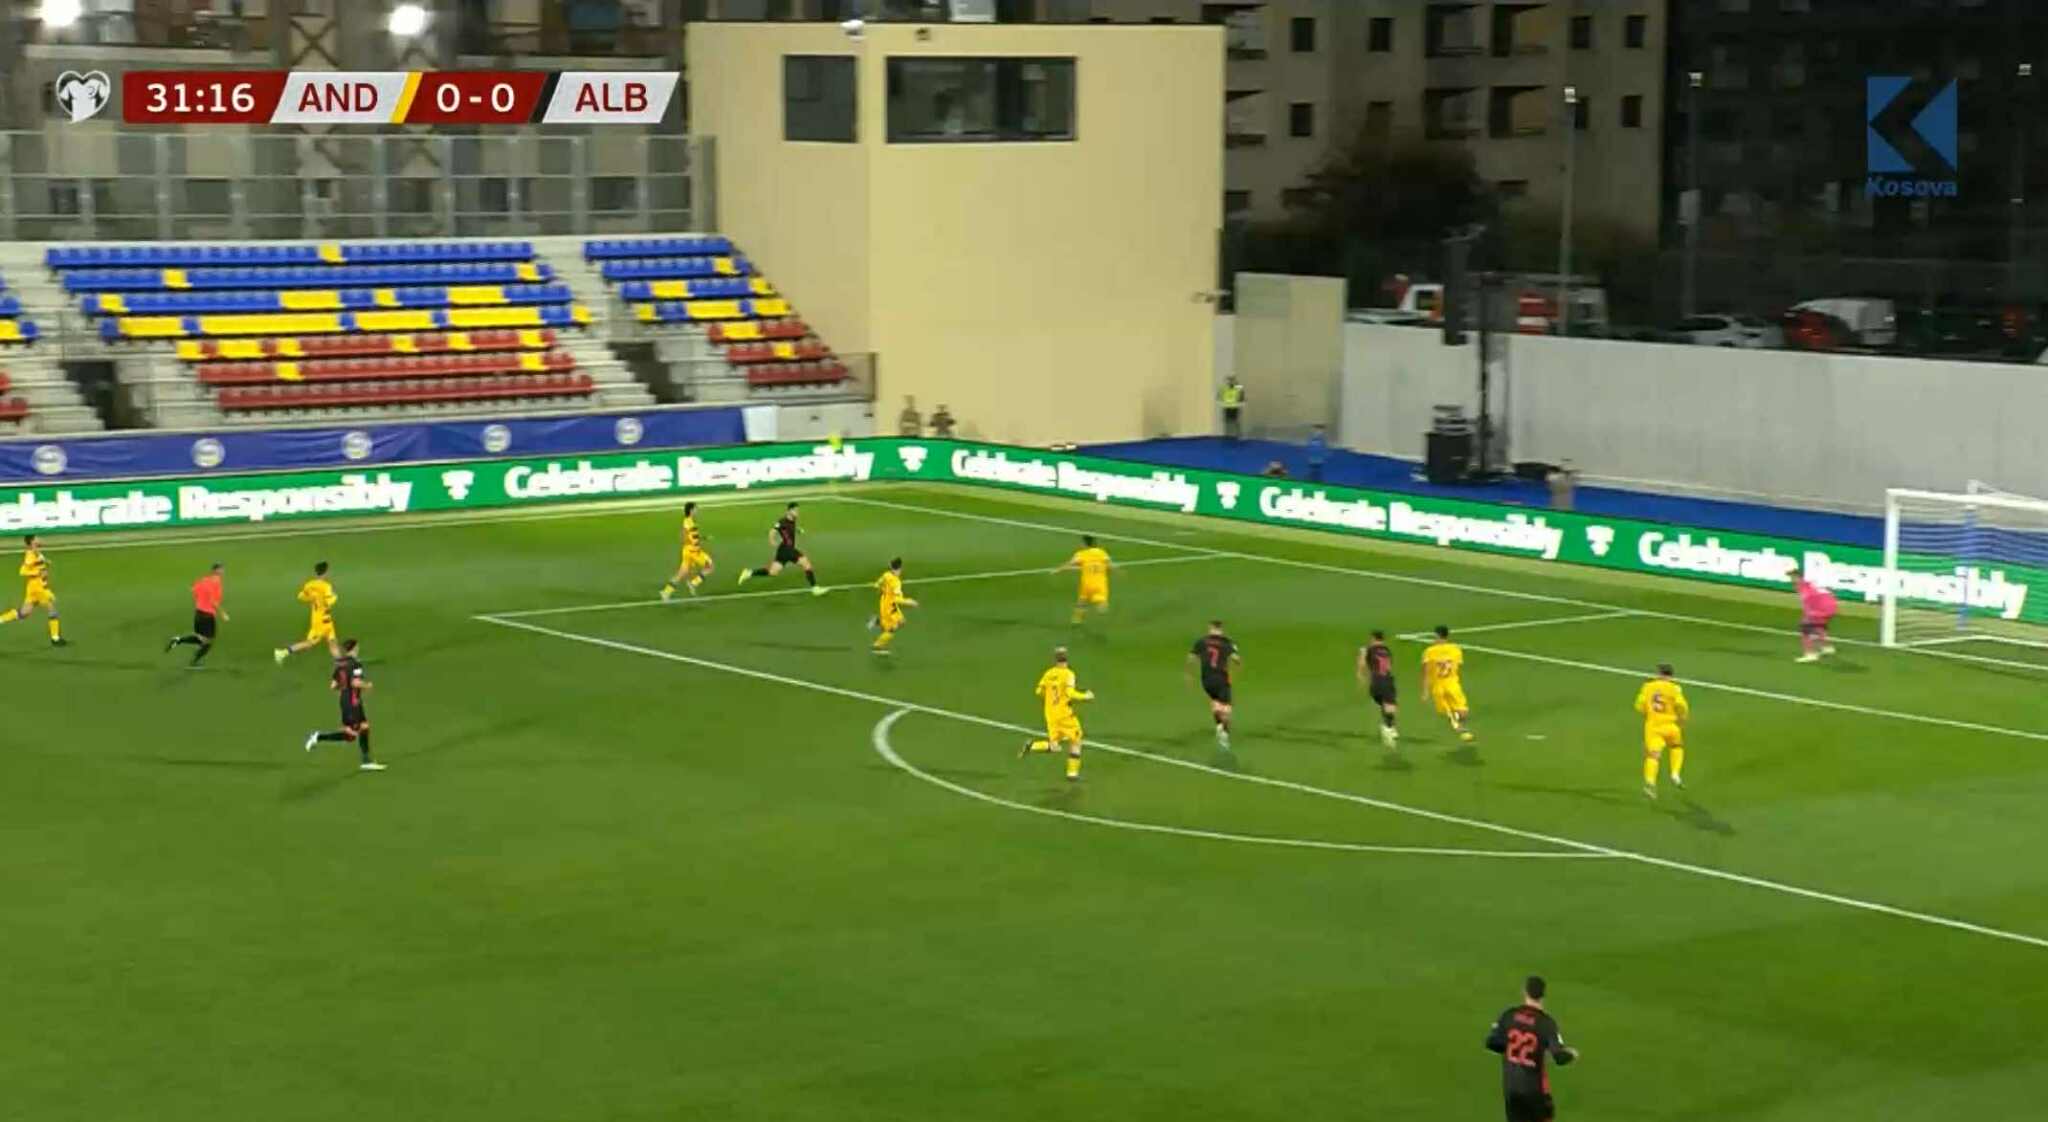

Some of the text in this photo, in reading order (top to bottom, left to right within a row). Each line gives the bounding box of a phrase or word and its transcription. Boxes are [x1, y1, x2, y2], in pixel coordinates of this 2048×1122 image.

[178, 473, 413, 521] Responsibly
[504, 444, 874, 498] Celebrate Responsibly
[952, 449, 1199, 512] Celebrate Responsibly
[1260, 486, 1563, 560] Celebrate Responsibly
[1639, 531, 1798, 582] Celebrate
[1506, 1028, 1538, 1068] 22
